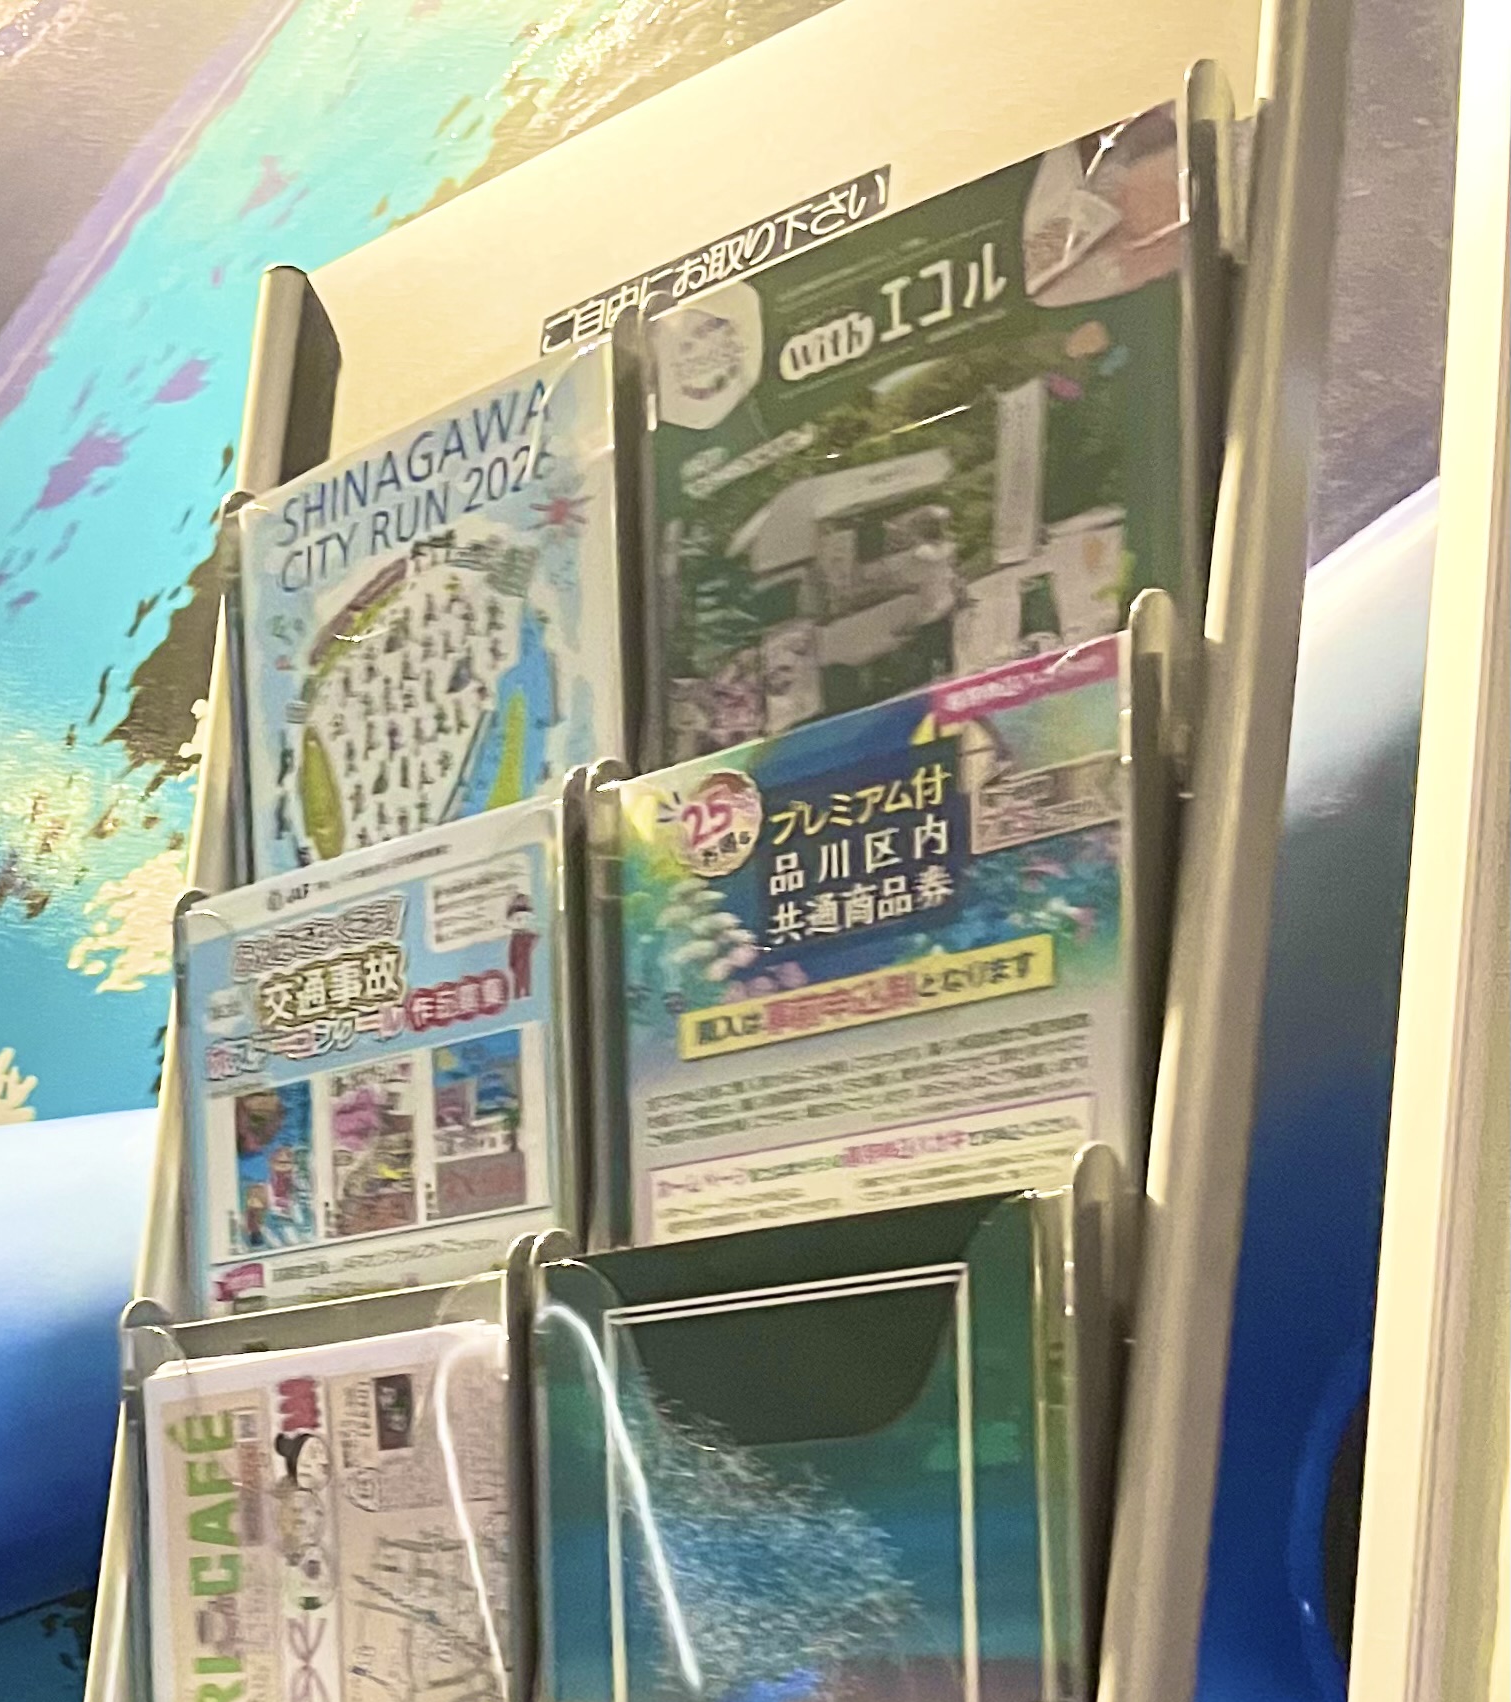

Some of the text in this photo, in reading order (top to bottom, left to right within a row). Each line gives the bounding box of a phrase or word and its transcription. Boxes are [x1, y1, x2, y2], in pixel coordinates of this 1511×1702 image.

[879, 242, 1008, 342] エコル
[276, 378, 551, 547] SHINAGAWA
[280, 520, 360, 592] CITY
[369, 481, 451, 556] RUN
[769, 763, 952, 846] プレミアム付
[769, 813, 950, 896] 品川区内
[766, 864, 955, 945] 共通商品券
[257, 945, 402, 1024] 交通事故
